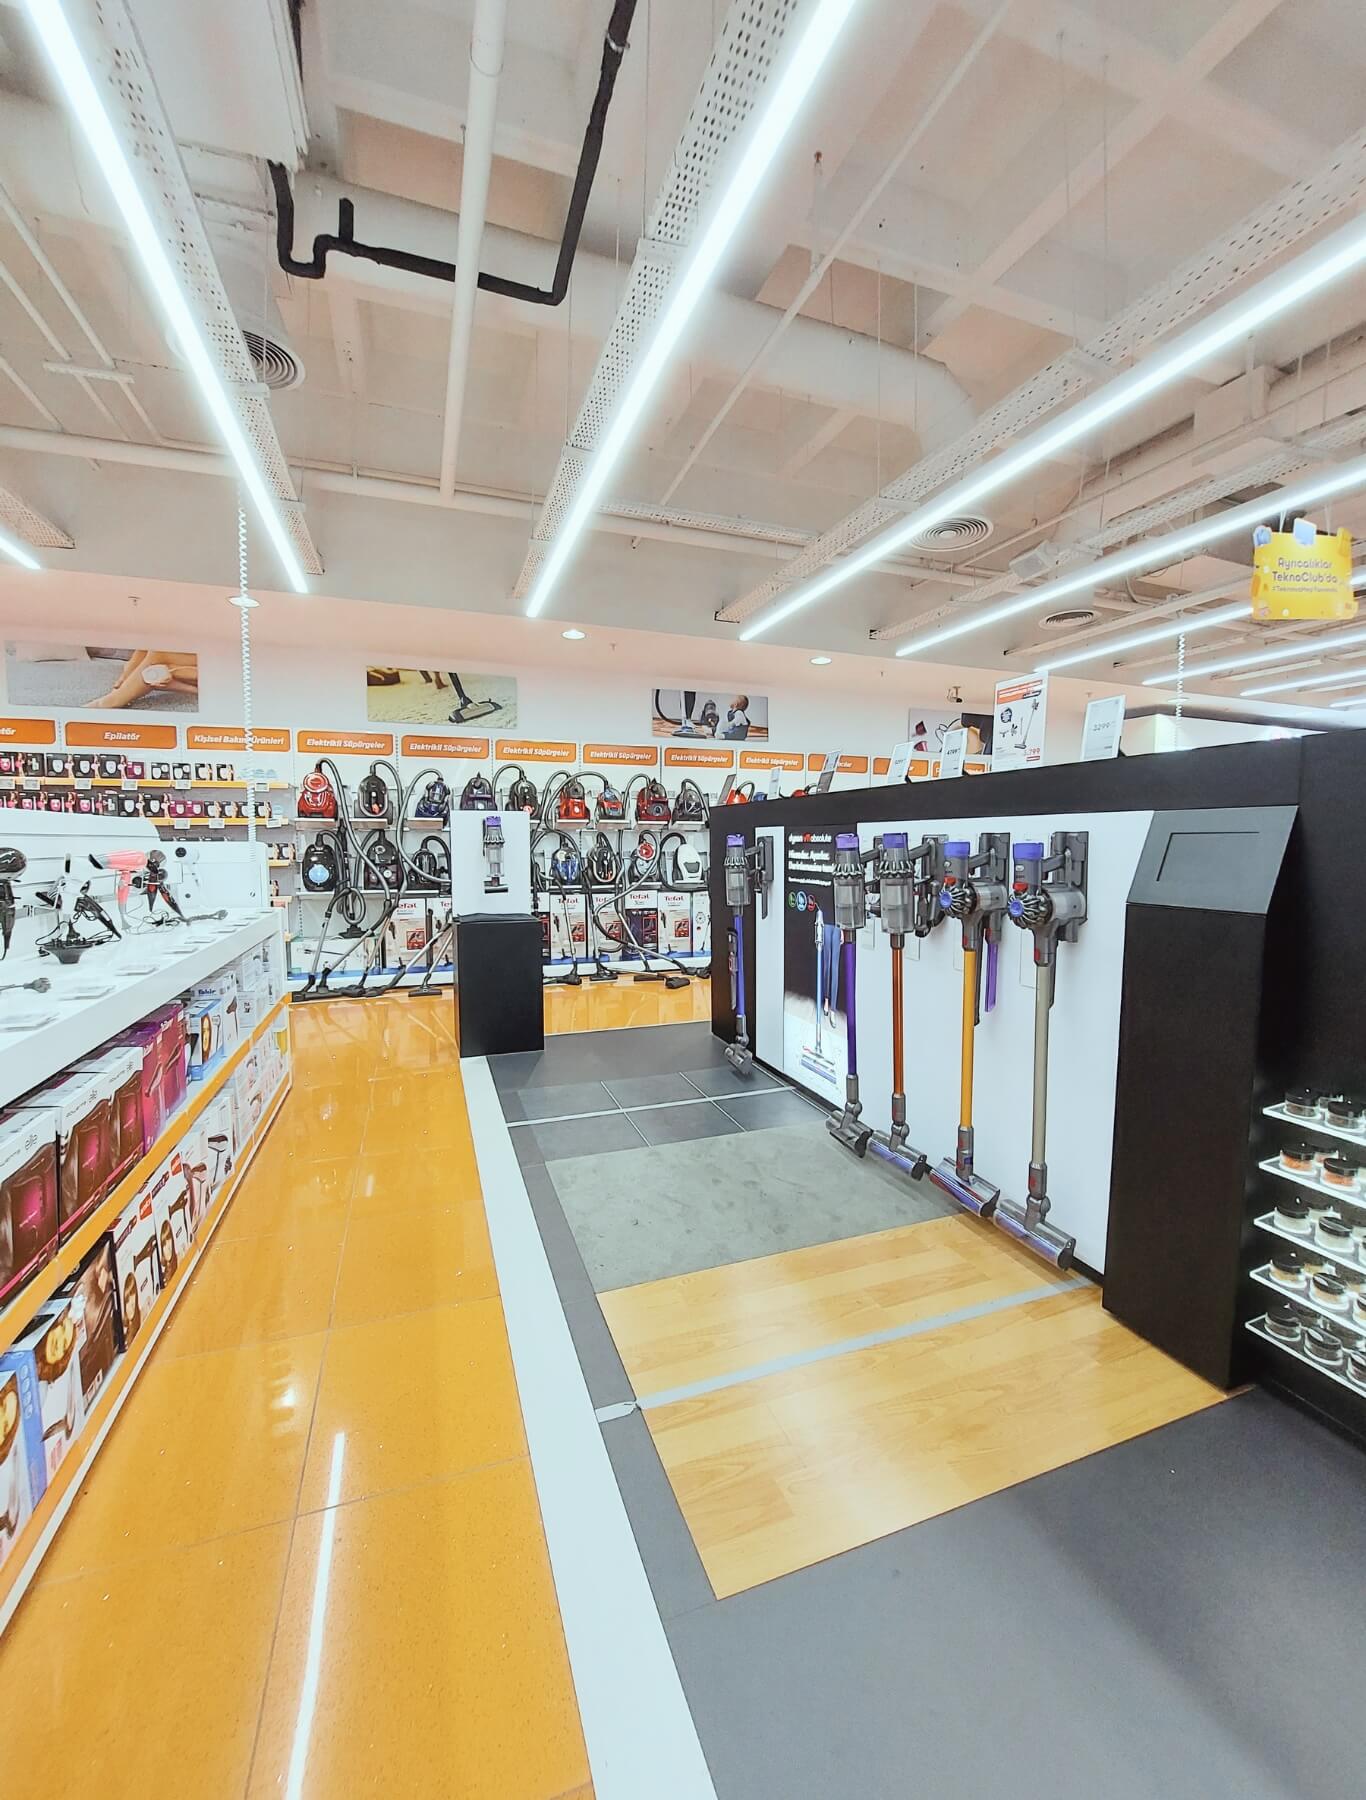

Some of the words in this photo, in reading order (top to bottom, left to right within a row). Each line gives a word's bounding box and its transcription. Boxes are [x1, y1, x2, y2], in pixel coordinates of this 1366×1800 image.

[104, 731, 141, 741] Epilatör
[194, 735, 223, 744] Kişisel
[251, 735, 285, 746] Ürünleri
[306, 738, 342, 748] Elektrikli
[343, 740, 385, 750] Süpürgeler
[410, 743, 443, 752] Elektrikli
[443, 744, 482, 754] Süpürgeler
[503, 747, 534, 756] Elektrikli
[534, 748, 570, 758] Süpürgeler
[590, 751, 618, 760] Elektrikli
[619, 752, 652, 761] Süpürgeler
[671, 754, 697, 762] Elektrikli
[698, 755, 728, 764] Süpürgeler
[746, 756, 770, 764] Elektrikli
[770, 758, 799, 767] Süpürgeler
